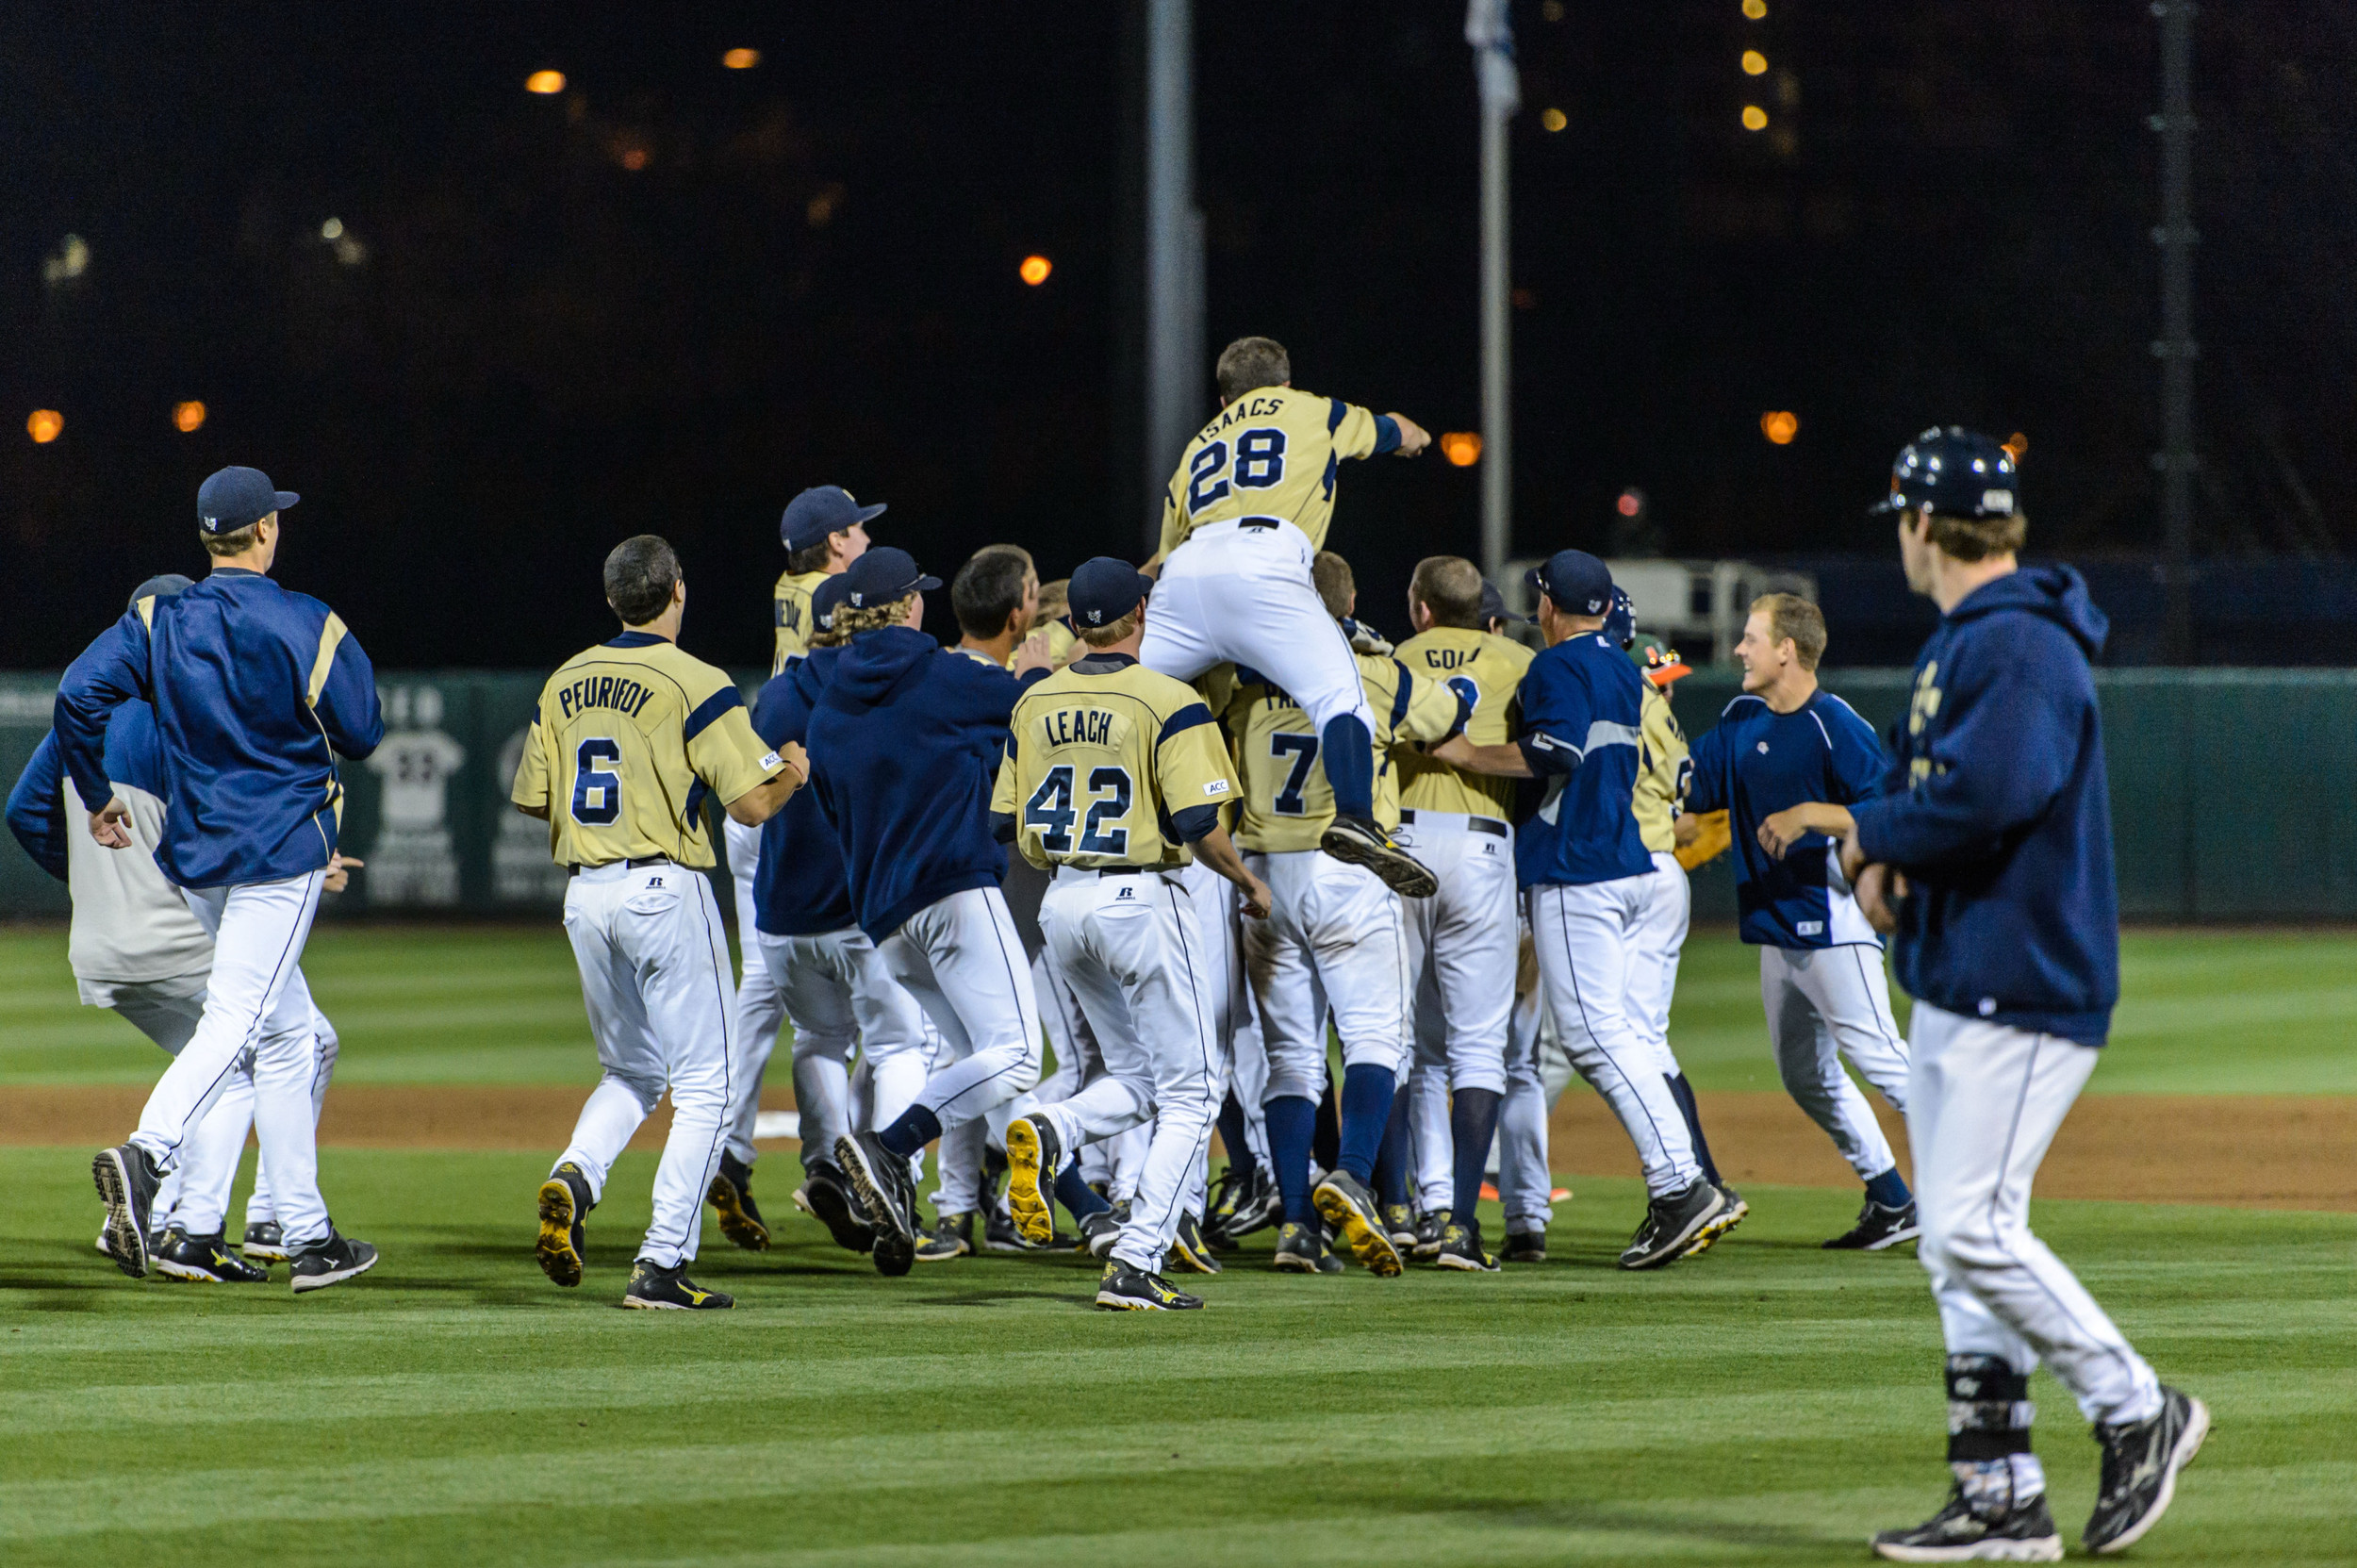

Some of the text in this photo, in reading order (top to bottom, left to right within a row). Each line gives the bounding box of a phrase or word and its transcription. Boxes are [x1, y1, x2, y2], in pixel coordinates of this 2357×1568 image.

[1197, 398, 1284, 443] ISAACS
[1187, 426, 1289, 518] 28
[559, 676, 654, 719] PEURIFOY
[1045, 710, 1113, 747] LEACH
[570, 737, 621, 826] 6
[1210, 782, 1228, 793] ACC
[1270, 731, 1320, 816] 7
[1024, 765, 1133, 857] 42
